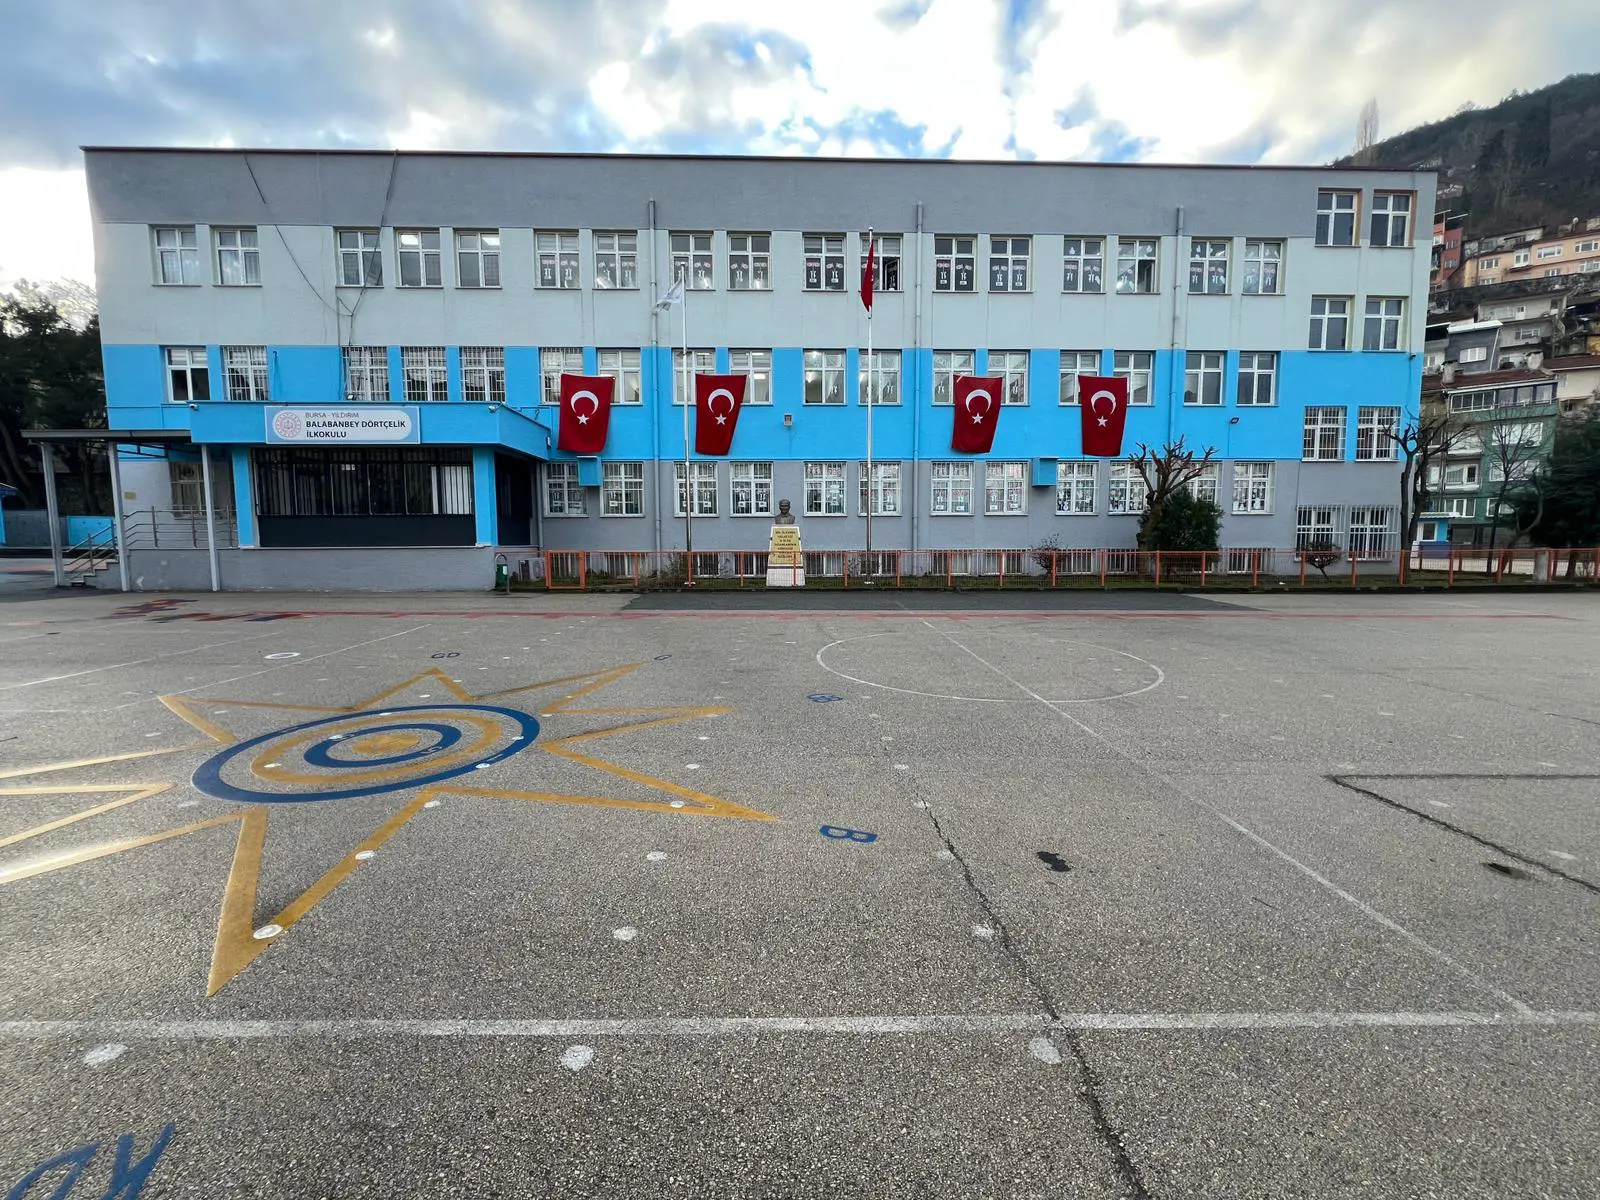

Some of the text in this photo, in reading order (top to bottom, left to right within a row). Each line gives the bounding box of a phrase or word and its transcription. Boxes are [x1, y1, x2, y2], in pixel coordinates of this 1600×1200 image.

[306, 419, 405, 430] BALABANBEY DÖRTÇELİK
[820, 825, 878, 843] B
